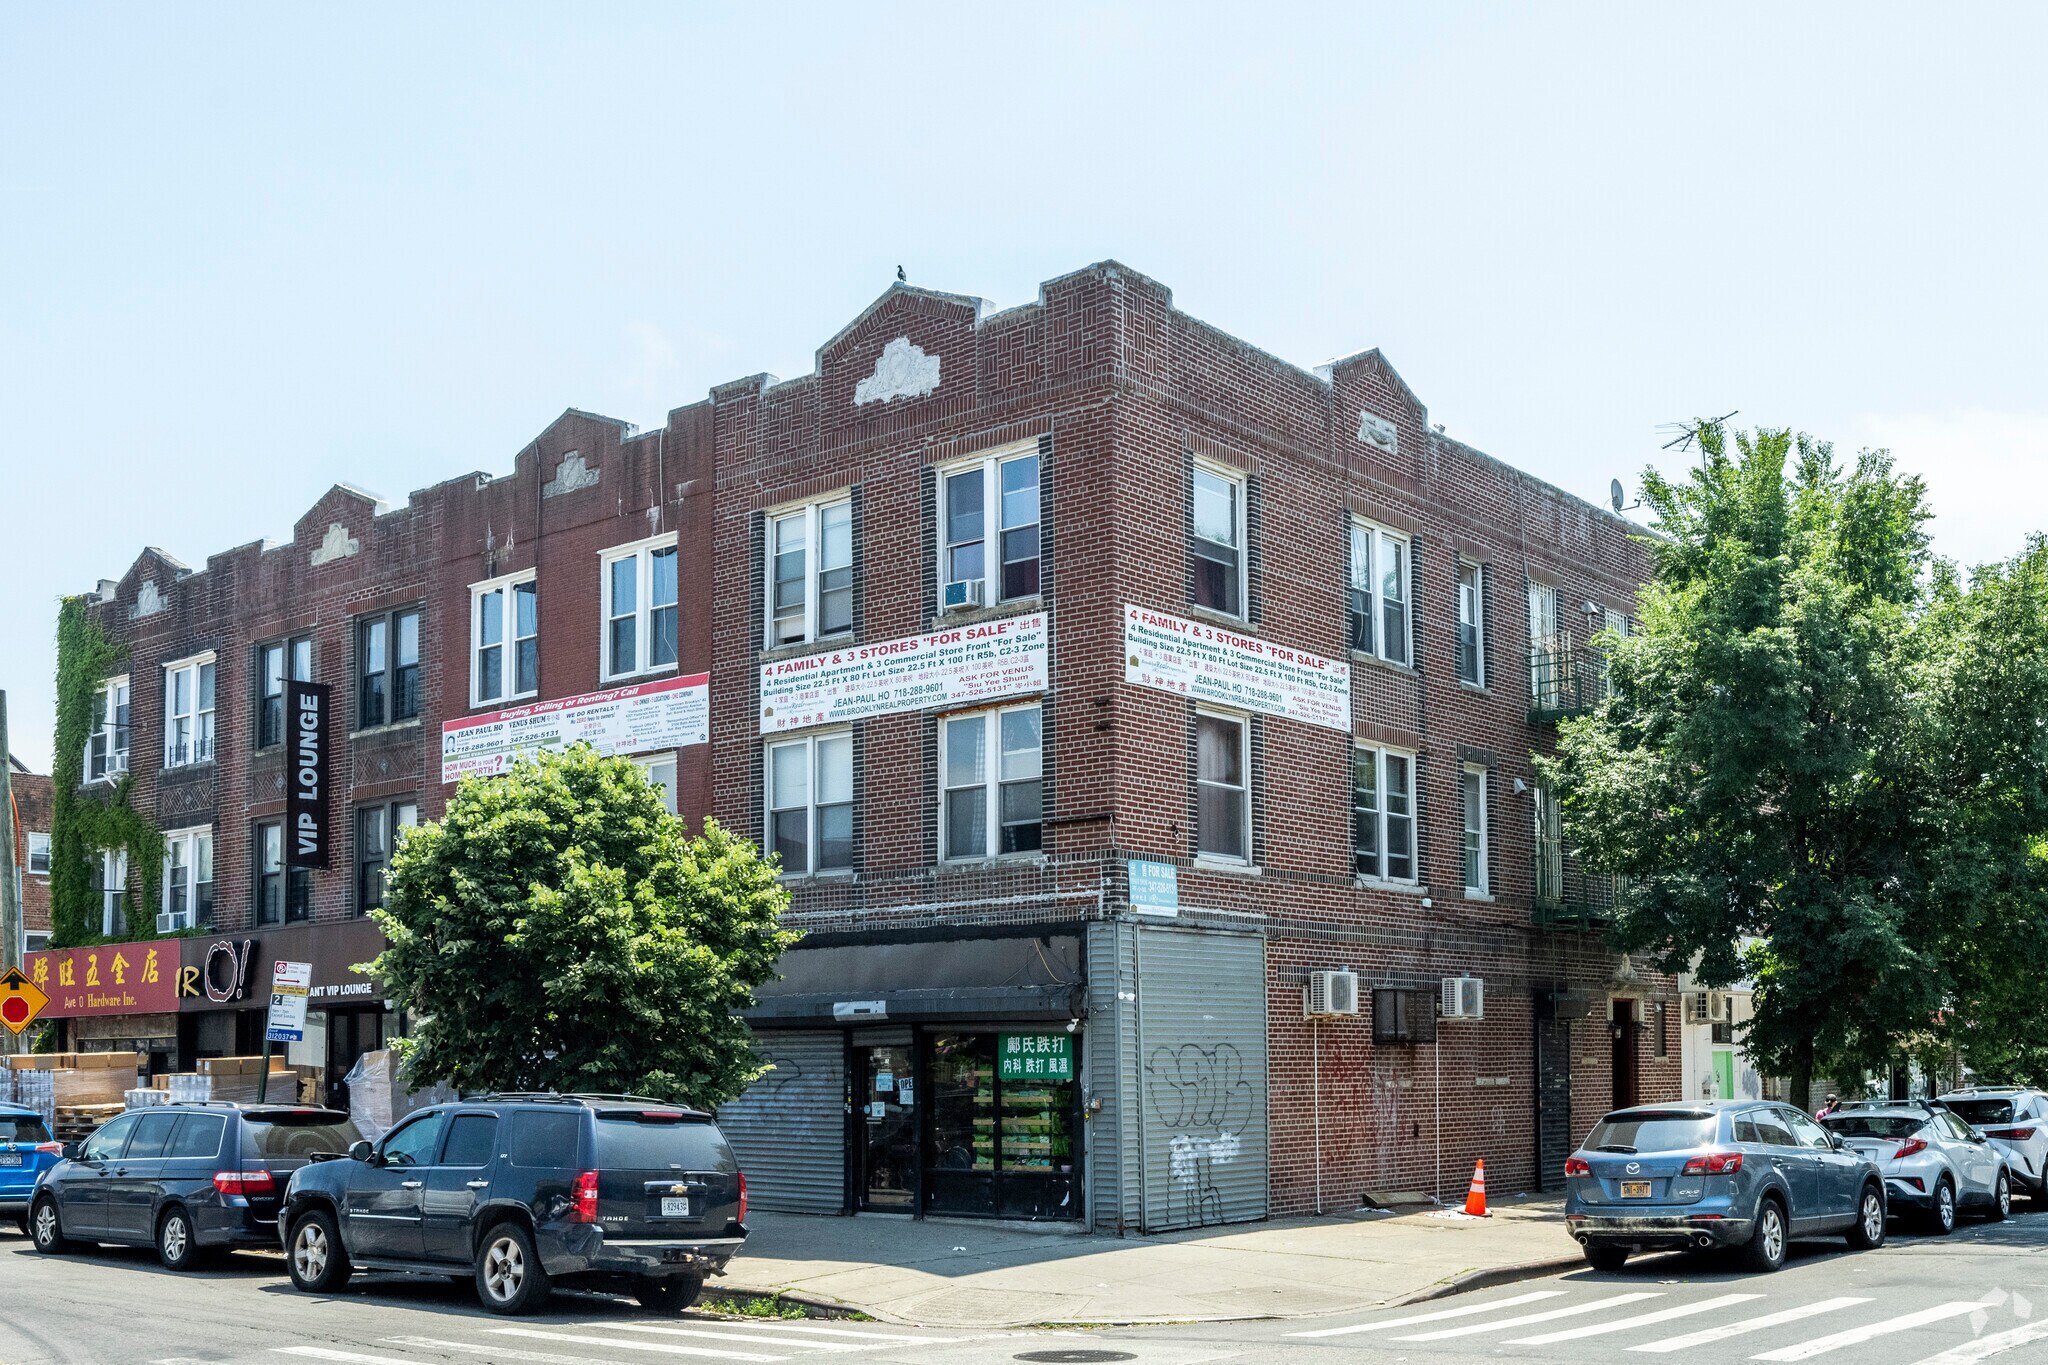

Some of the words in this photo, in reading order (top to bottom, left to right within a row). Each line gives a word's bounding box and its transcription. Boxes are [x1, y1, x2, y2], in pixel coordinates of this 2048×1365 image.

[765, 666, 772, 676] 4
[777, 656, 826, 674] FAMILY
[832, 653, 841, 664] &
[847, 651, 854, 661] 3
[860, 639, 918, 659] STORES
[923, 631, 960, 647] "FOR
[966, 621, 1014, 639] SALE"
[1130, 609, 1137, 620] 4
[1142, 612, 1187, 634] FAMILY
[1192, 625, 1201, 637] &
[1206, 629, 1211, 640] 3
[1216, 632, 1262, 653] STORES
[1266, 645, 1293, 661] "FOR
[1297, 653, 1329, 671] SALE"
[773, 671, 817, 686] Residential
[820, 663, 863, 679] Apartment
[867, 661, 872, 669] &
[884, 650, 936, 666] Commercial
[939, 645, 963, 656] Store
[966, 640, 990, 651] Front
[993, 636, 1012, 647] "For
[1015, 631, 1040, 643] Sale"
[1131, 623, 1135, 632] 4
[1138, 625, 1180, 643] Residential
[1182, 637, 1220, 655] Apartment
[1222, 647, 1227, 655] &
[1230, 649, 1233, 657] 3
[1236, 651, 1275, 668] Commercial
[1278, 662, 1295, 673] Store
[1297, 667, 1313, 677] Front
[1315, 671, 1327, 681] "For
[1329, 675, 1345, 686] Sale"
[763, 685, 793, 697] Building
[795, 682, 810, 691] Size
[813, 679, 829, 688] 22.5
[842, 675, 847, 683] X
[850, 673, 859, 681] 80
[872, 669, 885, 677] Lot
[888, 665, 904, 675] Size
[907, 662, 924, 671] 22.5
[927, 660, 936, 668] Ft
[938, 658, 944, 666] X
[947, 655, 962, 664] 100
[965, 653, 974, 661] Ft
[999, 645, 1019, 655] C2-3
[1022, 641, 1044, 651] Zone
[1128, 633, 1157, 649] Building
[1159, 641, 1174, 652] Size
[1176, 646, 1190, 656] 22.5
[1193, 650, 1199, 658] Ft
[1201, 652, 1206, 660] X
[1208, 654, 1216, 662] 80
[1218, 656, 1225, 664] Ft
[1227, 659, 1237, 667] Lot
[1239, 662, 1252, 671] Size
[1254, 665, 1267, 675] 22.5
[1269, 669, 1276, 677] Ft
[1278, 671, 1282, 679] X
[1284, 673, 1295, 682] 100
[1296, 676, 1303, 684] Ft
[1319, 682, 1332, 691] C2-3
[1334, 686, 1347, 695] Zone
[958, 674, 976, 682] ASK
[980, 670, 998, 679] FOR
[1002, 665, 1033, 675] VENUS
[1003, 673, 1028, 683] Shum
[833, 693, 875, 708] JEAN-PAUL
[878, 690, 889, 700] HO
[894, 681, 942, 698] 718-288-9601
[1194, 673, 1230, 691] JEAN-PAUL
[1232, 682, 1241, 693] HO
[1244, 685, 1281, 703] 718-288-9601
[500, 708, 531, 720] Buying,
[534, 700, 564, 713] Selling
[578, 690, 618, 705] Renting?
[621, 687, 639, 696] Call
[828, 692, 947, 718] WWW.BROOKLYNREALPROPERTY.COM
[1191, 684, 1285, 713] WWW.BROOKLYNREALPROPERTY.COM
[1292, 695, 1305, 703] ASK
[1307, 699, 1319, 707] FOR
[1322, 702, 1341, 712] VENUS
[586, 705, 613, 715] RENTALS
[509, 718, 527, 728] VENUS
[529, 715, 546, 725] SHUM
[457, 729, 474, 738] JEAN
[475, 726, 491, 734] PAUL
[509, 729, 558, 743] 347-526-5131
[298, 693, 318, 800] LOUNGE
[456, 739, 503, 752] 718-288-9601
[444, 763, 457, 771] HOW
[459, 759, 476, 769] MUCH
[444, 770, 463, 780] HOM
[298, 812, 317, 855] VIP
[326, 985, 339, 996] VIP
[340, 983, 372, 996] LOUNGE
[63, 996, 76, 1009] Ave
[86, 993, 120, 1008] Hardware
[122, 991, 136, 1006] Inc.
[274, 995, 281, 1004] 2
[268, 1032, 289, 1040] 312037
[900, 1078, 913, 1089] OPE
